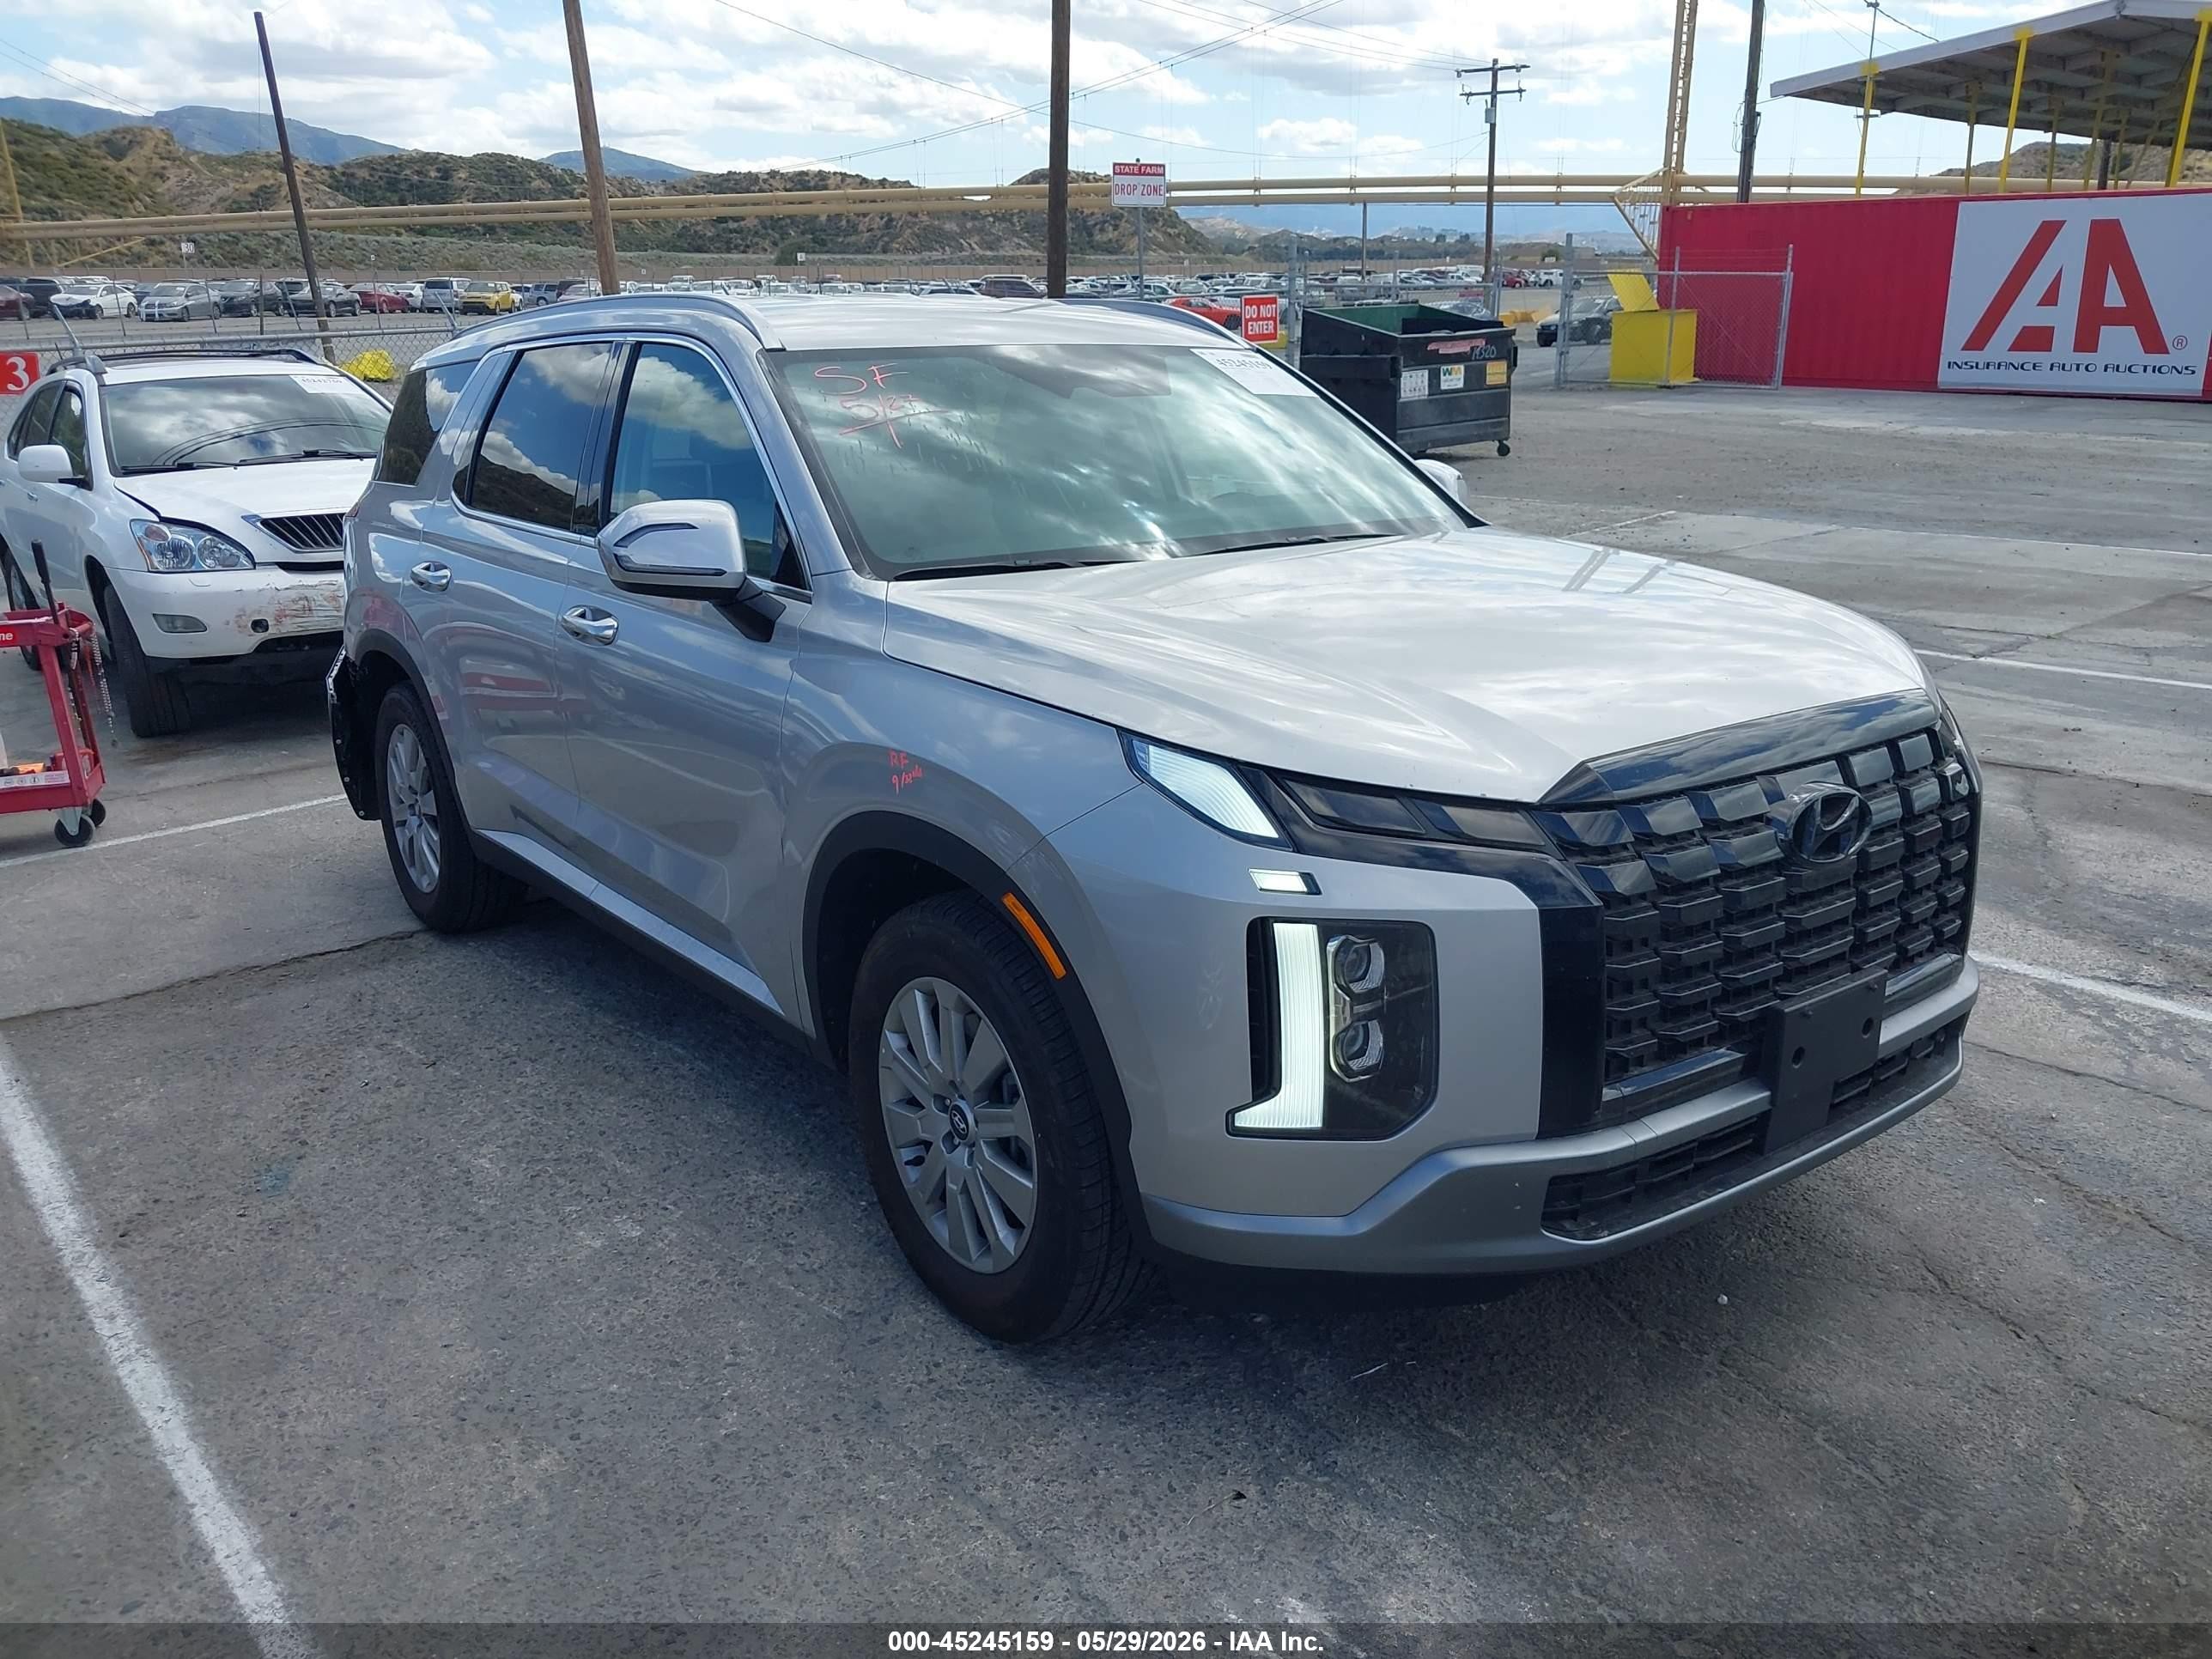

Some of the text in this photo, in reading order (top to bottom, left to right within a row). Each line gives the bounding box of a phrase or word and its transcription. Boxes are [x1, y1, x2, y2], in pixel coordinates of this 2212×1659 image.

[1115, 165, 1164, 174] STATE FARM
[1115, 183, 1164, 197] DROP ZONE
[1245, 304, 1276, 319] DO NOT
[1248, 320, 1274, 335] ENTER
[1442, 367, 1462, 377] WM
[1947, 361, 2198, 375] INSURANCE AUTO AUCTIONS
[814, 362, 910, 396] SF
